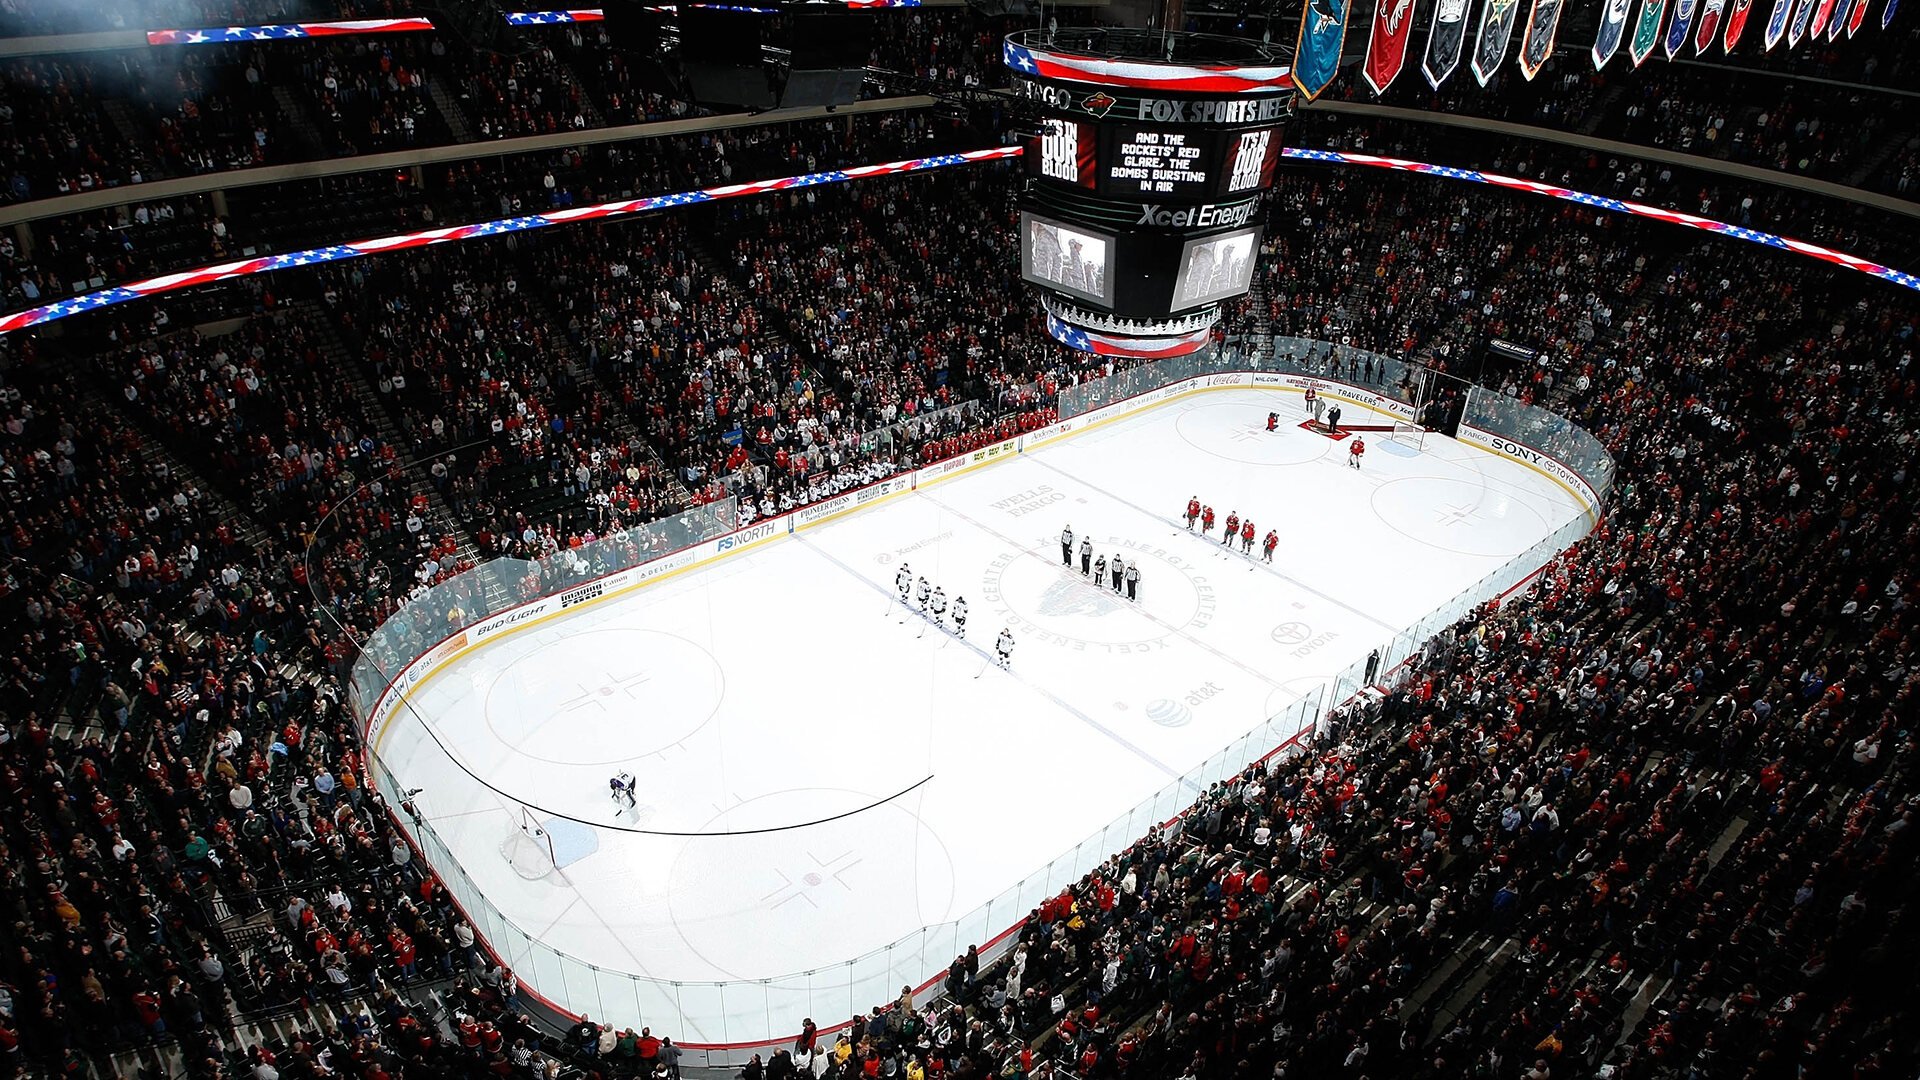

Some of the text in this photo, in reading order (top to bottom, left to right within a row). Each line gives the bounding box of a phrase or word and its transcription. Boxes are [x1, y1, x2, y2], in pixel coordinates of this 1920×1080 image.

[1138, 99, 1282, 122] FOX SPORTS NET
[1064, 121, 1078, 141] IN
[1135, 132, 1185, 146] AND THE
[1238, 130, 1272, 150] IT'S IN
[1041, 135, 1078, 167] OUR
[1121, 144, 1200, 159] ROCKETS' RED
[1041, 158, 1078, 182] BLOOD
[1124, 156, 1191, 170] GLARE, THE
[1232, 147, 1266, 176] OUR
[1111, 167, 1206, 183] BOMBS BURSTING
[1228, 172, 1261, 192] BLOOD
[1140, 180, 1174, 192] IN AIR
[1136, 203, 1196, 227] Xcel
[1197, 202, 1252, 229] Energy
[1510, 344, 1534, 355] LIGHT
[1337, 388, 1377, 406] TRAVELERS
[1399, 407, 1415, 416] Xcel
[1463, 430, 1488, 442] FARGO
[1491, 438, 1542, 464] SONY
[1555, 468, 1581, 490] TOYOTA
[991, 484, 1053, 510] WELLS
[1008, 491, 1066, 518] FARGO
[800, 501, 830, 519] PIONEER
[603, 575, 628, 588] Canon
[561, 583, 602, 601] Imaging
[477, 604, 547, 636] BUD LIGHT
[1290, 630, 1340, 660] TOYOTA
[1184, 679, 1225, 707] at&t
